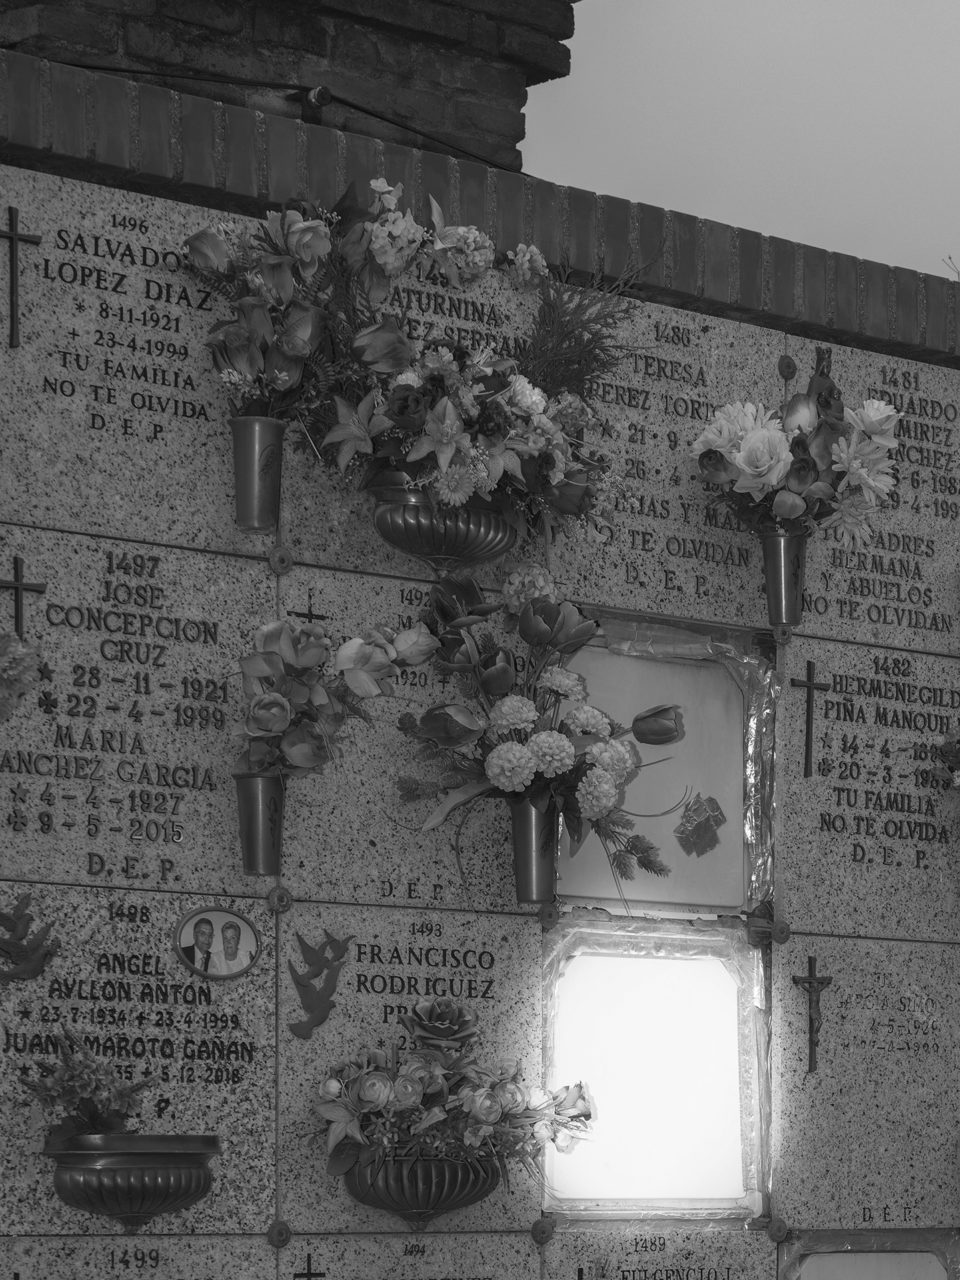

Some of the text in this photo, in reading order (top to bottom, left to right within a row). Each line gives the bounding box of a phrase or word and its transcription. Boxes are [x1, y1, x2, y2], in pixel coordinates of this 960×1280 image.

[111, 215, 149, 235] 1496
[43, 259, 213, 312] LOPEZ DIAZ
[100, 303, 180, 333] 8-11-1921
[94, 330, 188, 361] 23-4-1999
[654, 320, 691, 347] 1486
[59, 351, 196, 391] TU FAMILIA
[629, 353, 708, 387] TERESA
[880, 366, 920, 392] 1481
[43, 376, 210, 422] NO TE OLVIDA
[586, 379, 651, 410] PEREZ
[106, 551, 161, 578] 1497
[666, 536, 750, 568] OLVIDAN
[831, 548, 923, 580] HERMANA
[102, 580, 164, 610] JOSE
[847, 576, 933, 608] ABUELOS
[46, 603, 219, 644] CONCEPCION
[867, 603, 952, 632] OLVIDAN
[100, 639, 166, 667] CRUZ
[873, 656, 911, 677] 1482
[824, 698, 867, 723] PIÑA
[54, 725, 146, 755] MARIA
[116, 759, 217, 791] GARCIA
[864, 791, 936, 817] FAMILIA
[884, 820, 950, 844] OLVIDA
[109, 903, 150, 923] 1498
[410, 921, 443, 937] 1493
[96, 953, 165, 976] ANGEL
[356, 943, 495, 970] FRANCISCO
[140, 983, 212, 1005] ANTON
[356, 973, 495, 999] RODRIGUEZ
[84, 1034, 175, 1058] MAROTO
[403, 1243, 426, 1257] 1494
[634, 1237, 666, 1252] 1489
[109, 1249, 161, 1269] 1499
